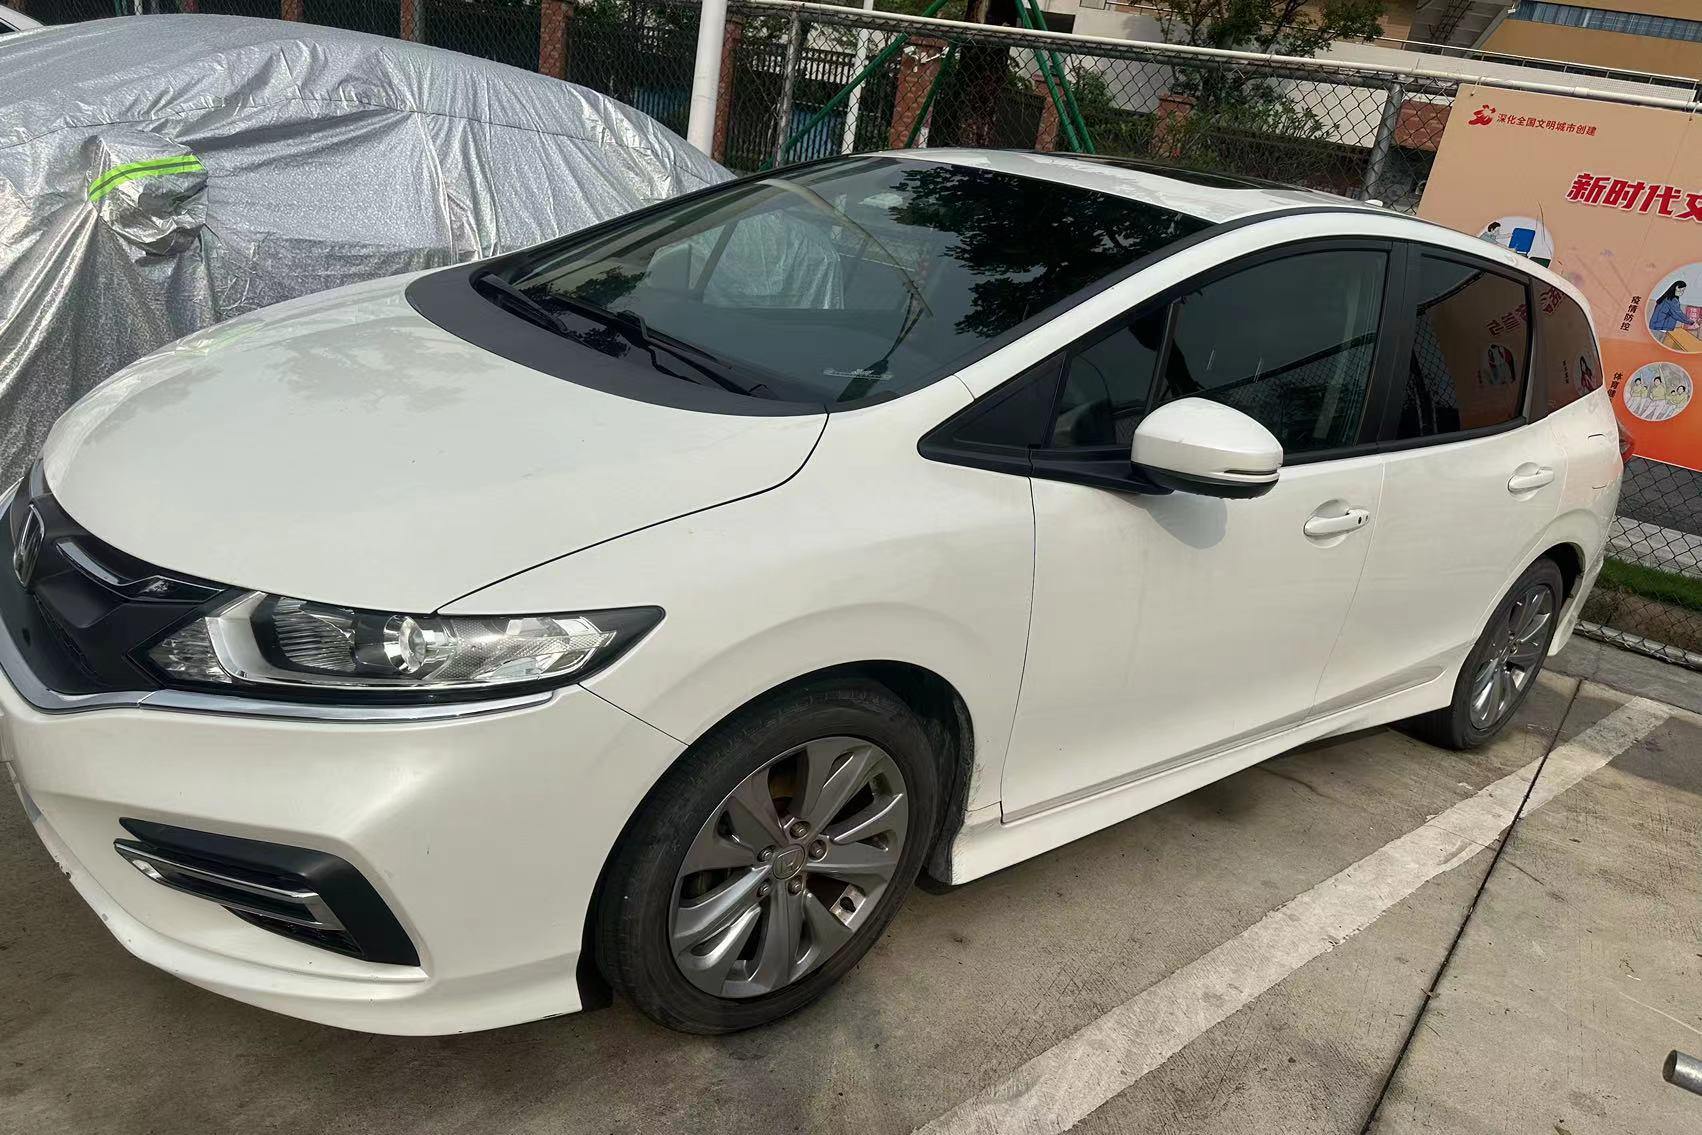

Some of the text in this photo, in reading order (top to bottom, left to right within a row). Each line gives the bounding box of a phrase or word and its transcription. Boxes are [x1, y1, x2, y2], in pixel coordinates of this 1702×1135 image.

[1497, 113, 1597, 136] 深化全国文明城市创建
[1619, 295, 1642, 332] 疫情防控
[1607, 372, 1623, 401] 体育健
